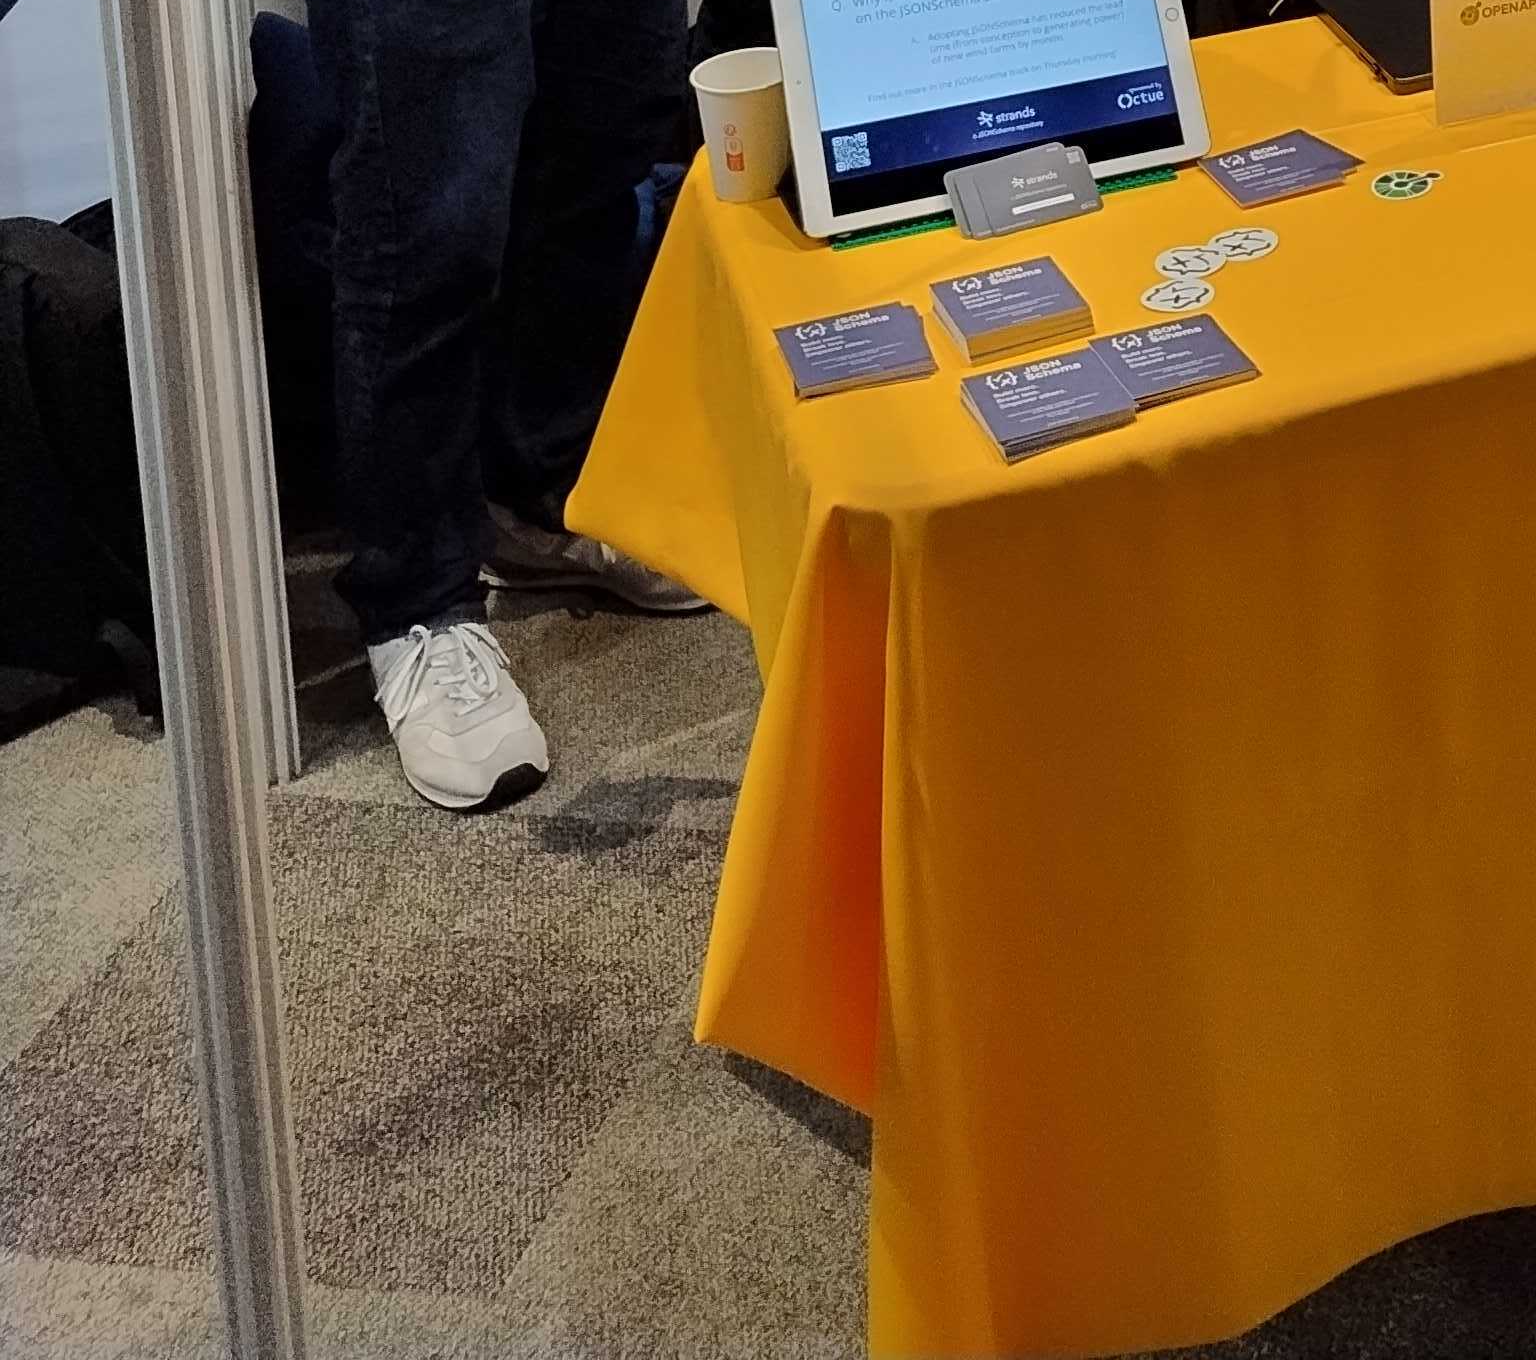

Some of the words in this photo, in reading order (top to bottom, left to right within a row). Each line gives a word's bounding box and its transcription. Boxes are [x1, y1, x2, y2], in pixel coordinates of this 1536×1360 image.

[855, 12, 873, 24] on
[875, 6, 897, 21] the
[1117, 90, 1165, 110] Octue
[994, 105, 1037, 125] strands
[1023, 359, 1062, 375] JSON
